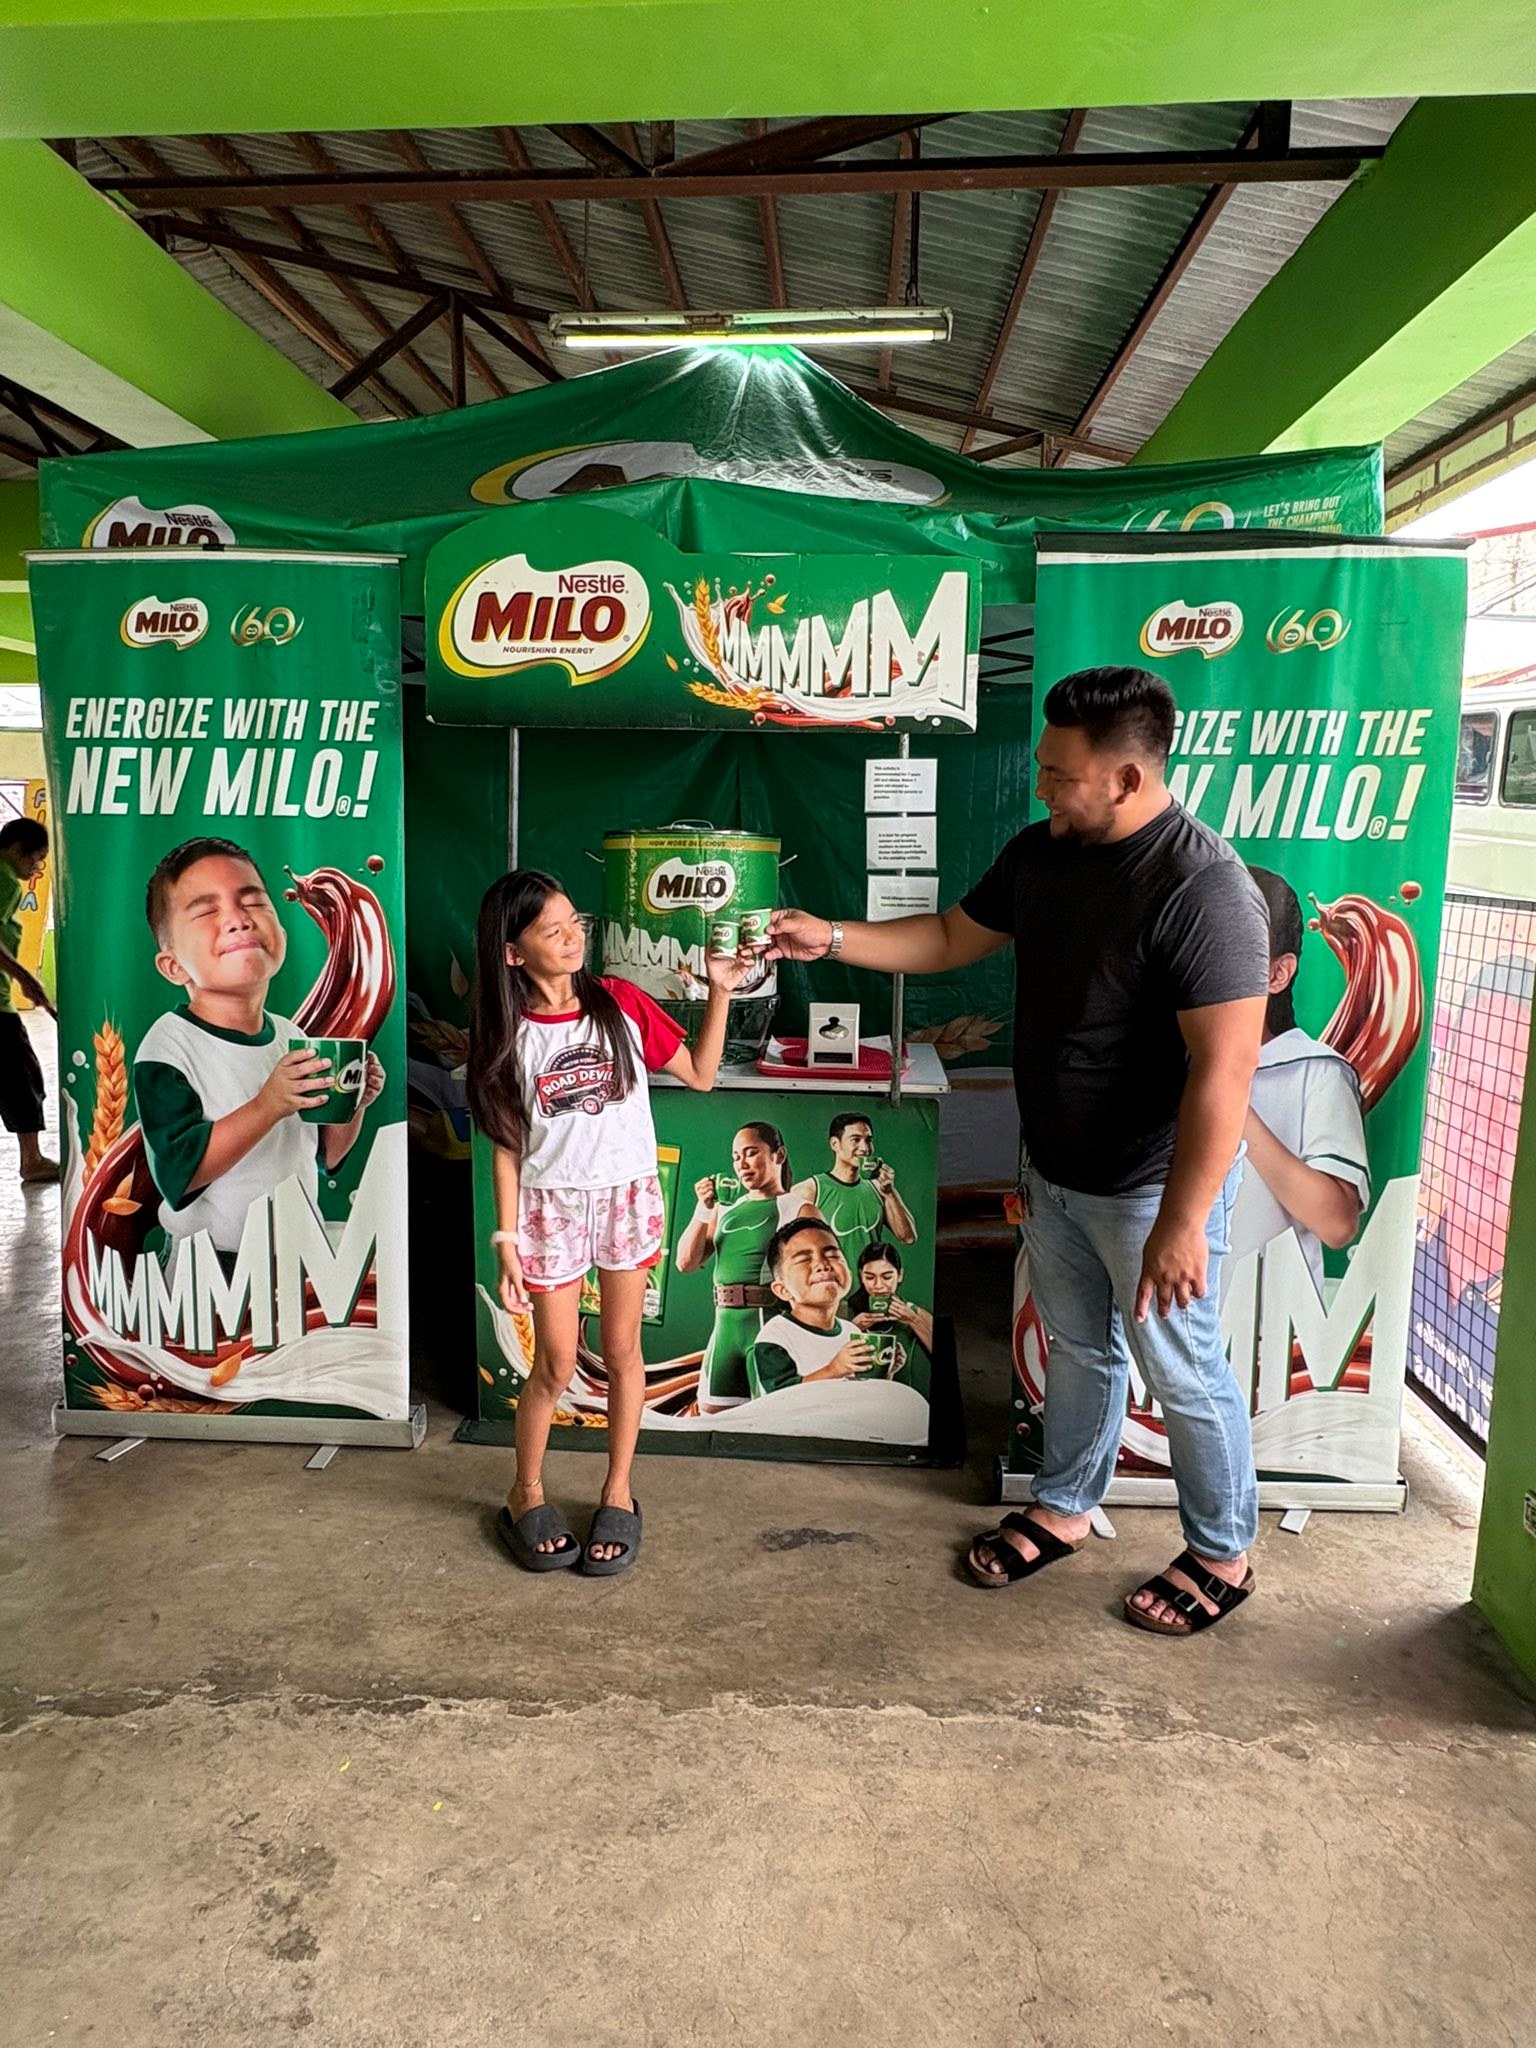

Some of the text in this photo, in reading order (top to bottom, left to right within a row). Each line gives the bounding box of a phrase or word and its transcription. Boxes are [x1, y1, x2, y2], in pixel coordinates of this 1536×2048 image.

[1263, 495, 1342, 518] LET'S BRING OUT
[164, 512, 215, 528] Nestlé
[1267, 510, 1335, 529] THE CHAMPION
[107, 521, 220, 547] MILO
[558, 574, 626, 594] Nestlé
[135, 612, 199, 634] MILO
[471, 591, 627, 643] MILO
[1156, 617, 1232, 641] MILO
[502, 646, 595, 655] NOURISHING ENERGY
[65, 696, 381, 742] ENERGIZE WITH THE
[1168, 708, 1433, 757] GIZE WITH THE
[66, 746, 194, 816] NEW
[667, 840, 686, 848] MORE
[656, 874, 727, 898] MILO
[541, 1073, 577, 1097] ROAD
